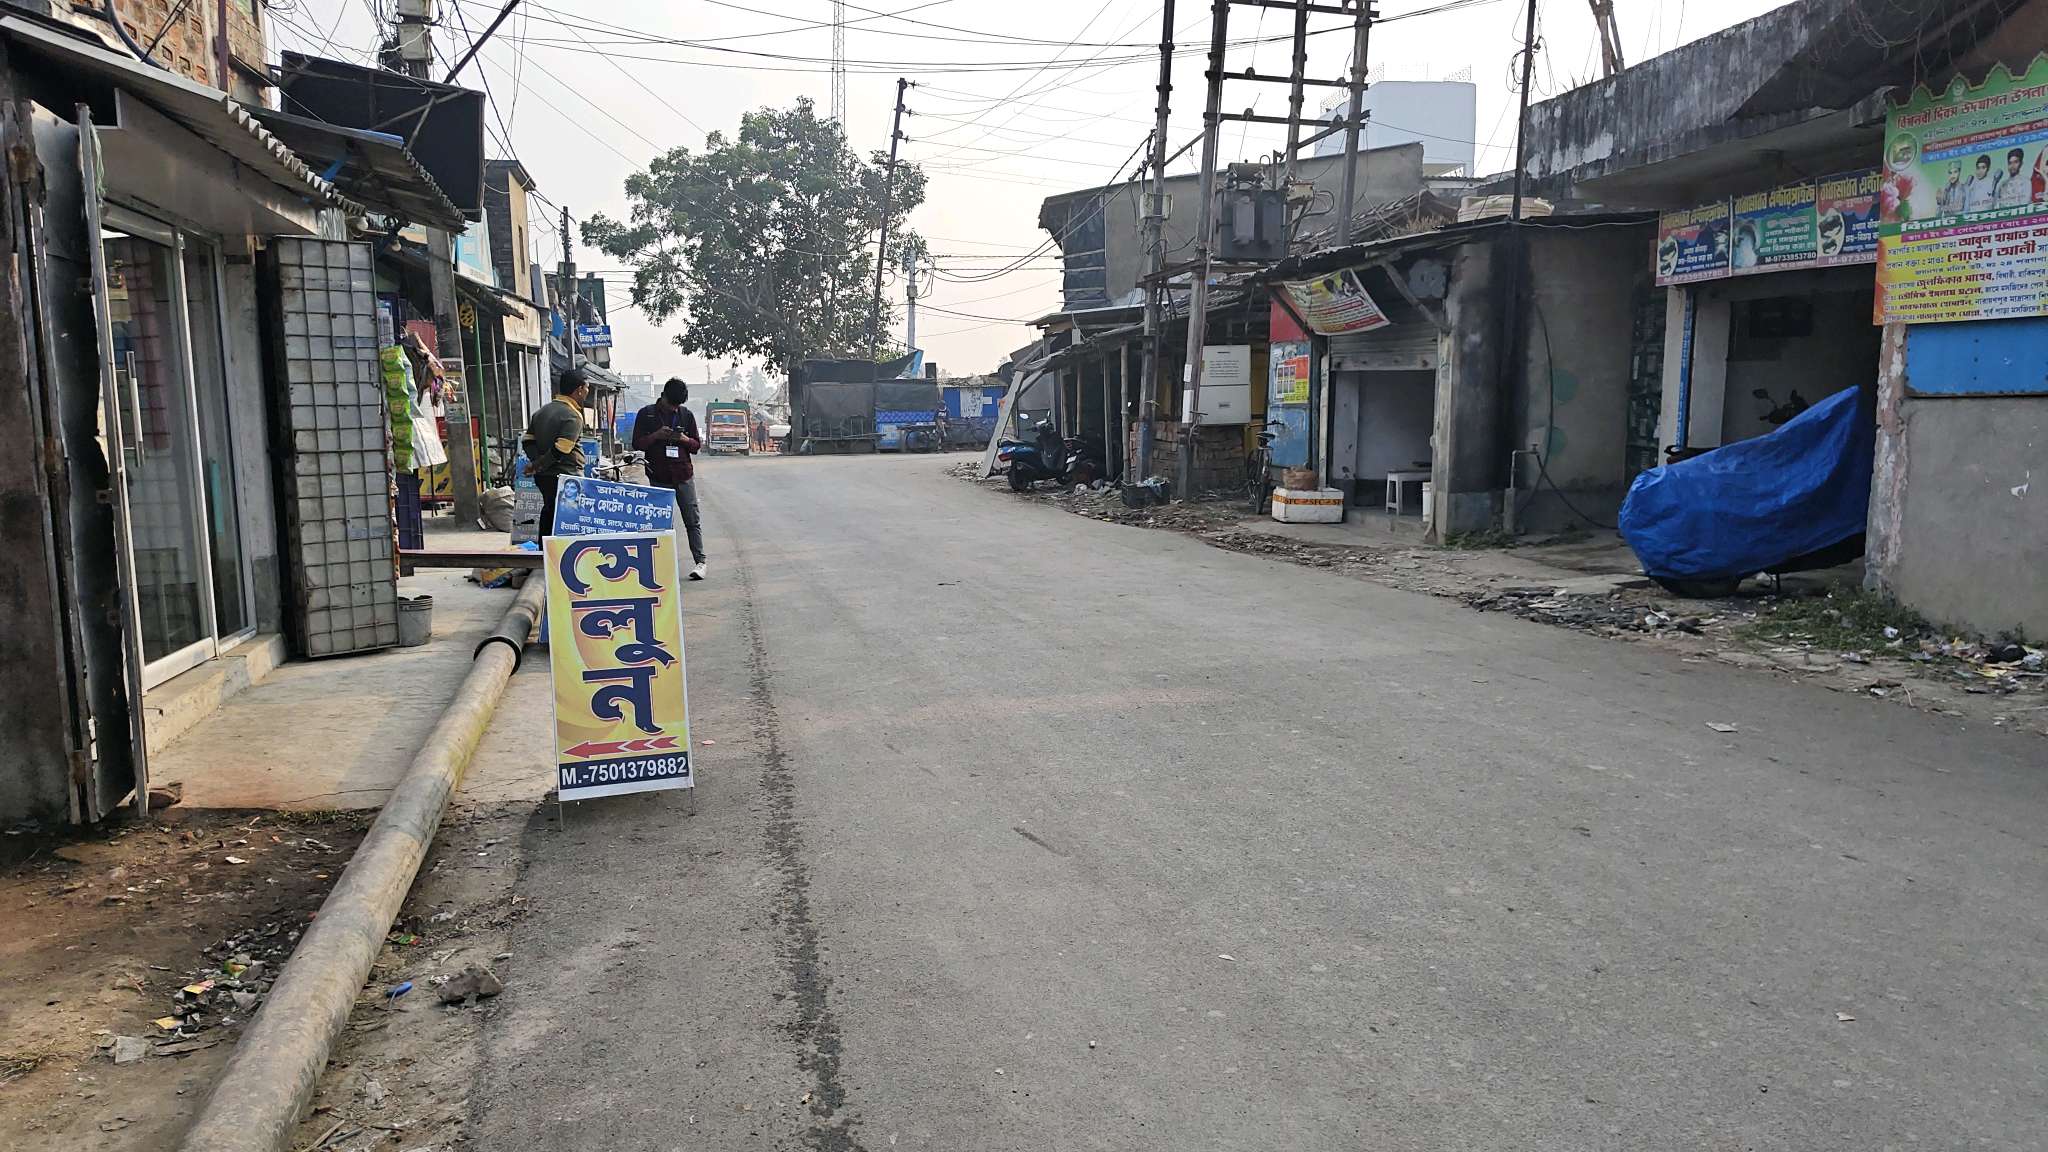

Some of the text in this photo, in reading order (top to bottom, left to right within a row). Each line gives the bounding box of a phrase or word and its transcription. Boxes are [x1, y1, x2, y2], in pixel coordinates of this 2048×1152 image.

[1901, 216, 1957, 232] বিরাট
[1958, 235, 1991, 249] আবুল
[1995, 231, 2029, 243] হায়াত
[1947, 248, 1992, 263] শোয়েব
[1997, 240, 2036, 257] আলী
[595, 485, 649, 500] আশীর্বাদ
[577, 494, 596, 514] হিন্দু
[597, 498, 625, 513] হোটেল
[626, 503, 632, 515] ও
[560, 537, 676, 734] সেলুন
[561, 756, 687, 786] M.-7501379882
